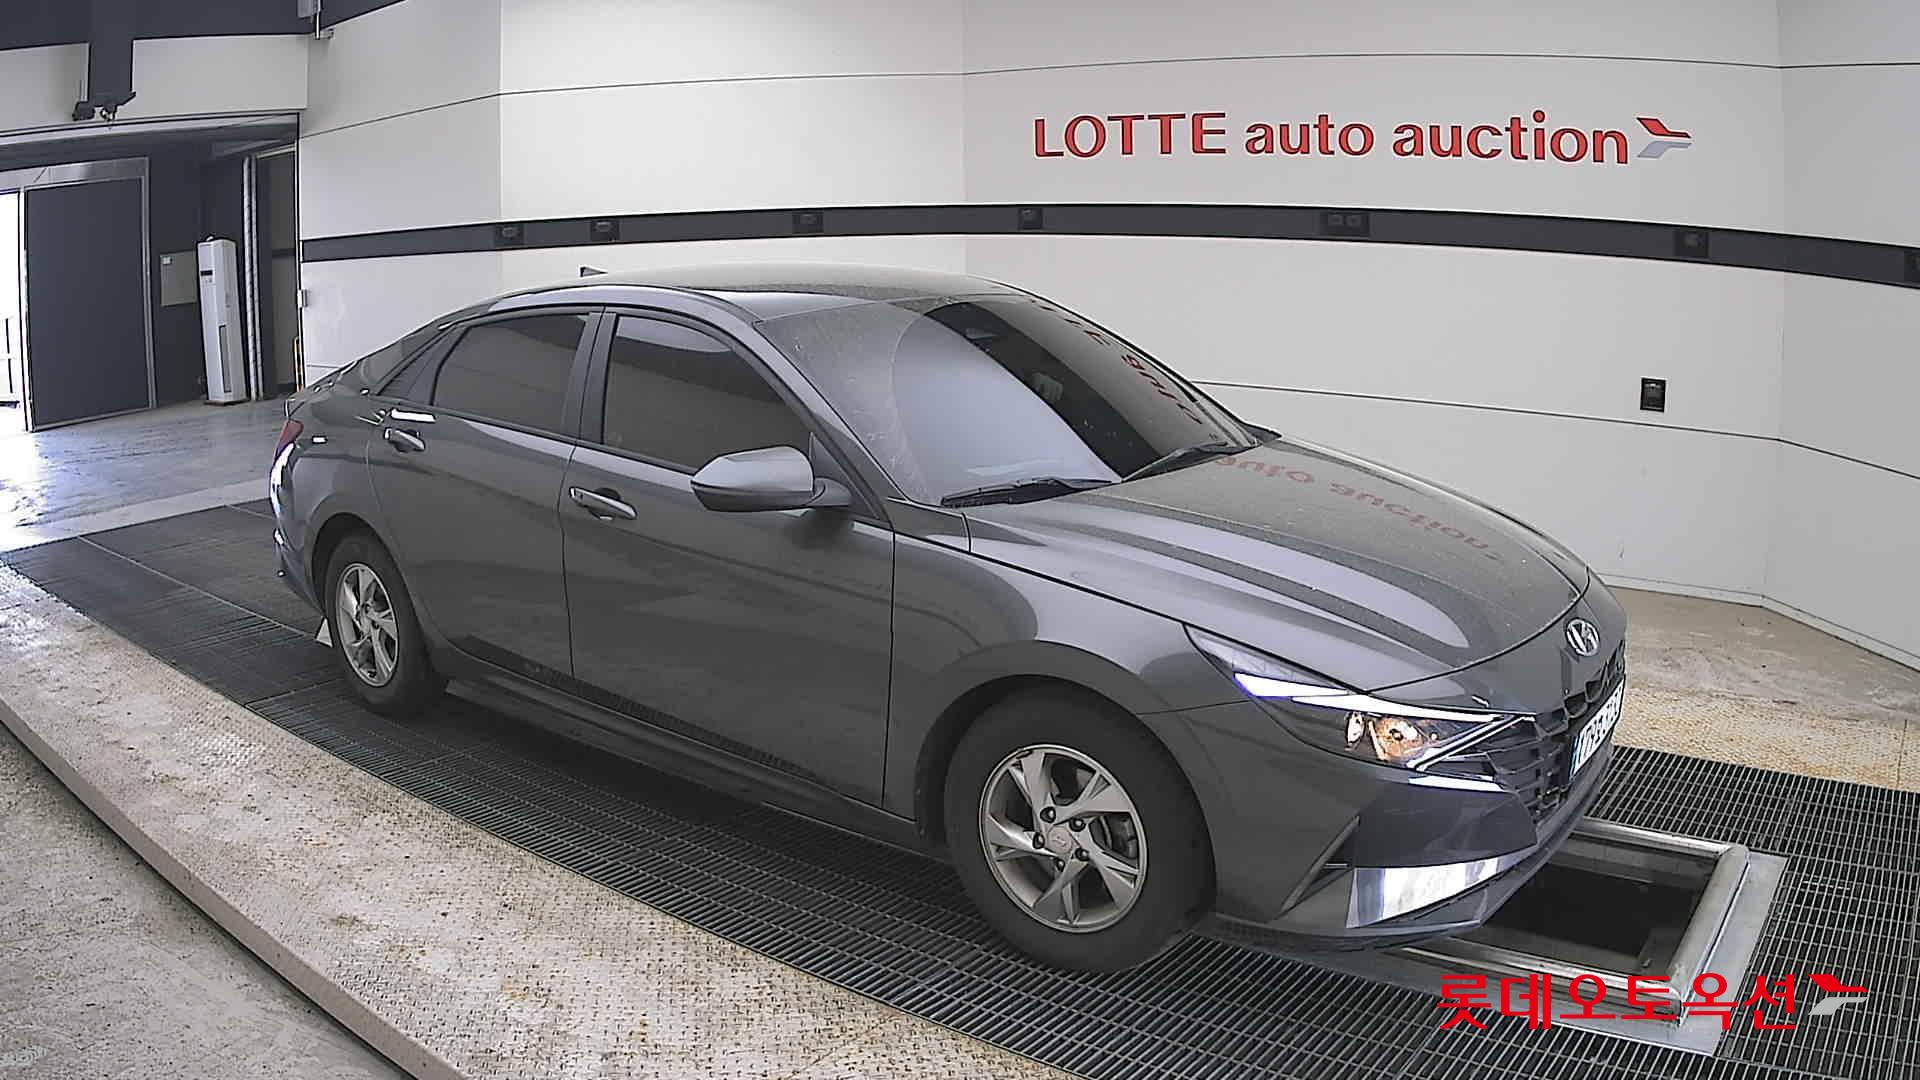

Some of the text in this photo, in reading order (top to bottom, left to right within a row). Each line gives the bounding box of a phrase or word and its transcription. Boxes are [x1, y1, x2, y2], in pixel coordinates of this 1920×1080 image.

[1034, 110, 1628, 165] LOTTE auto auction
